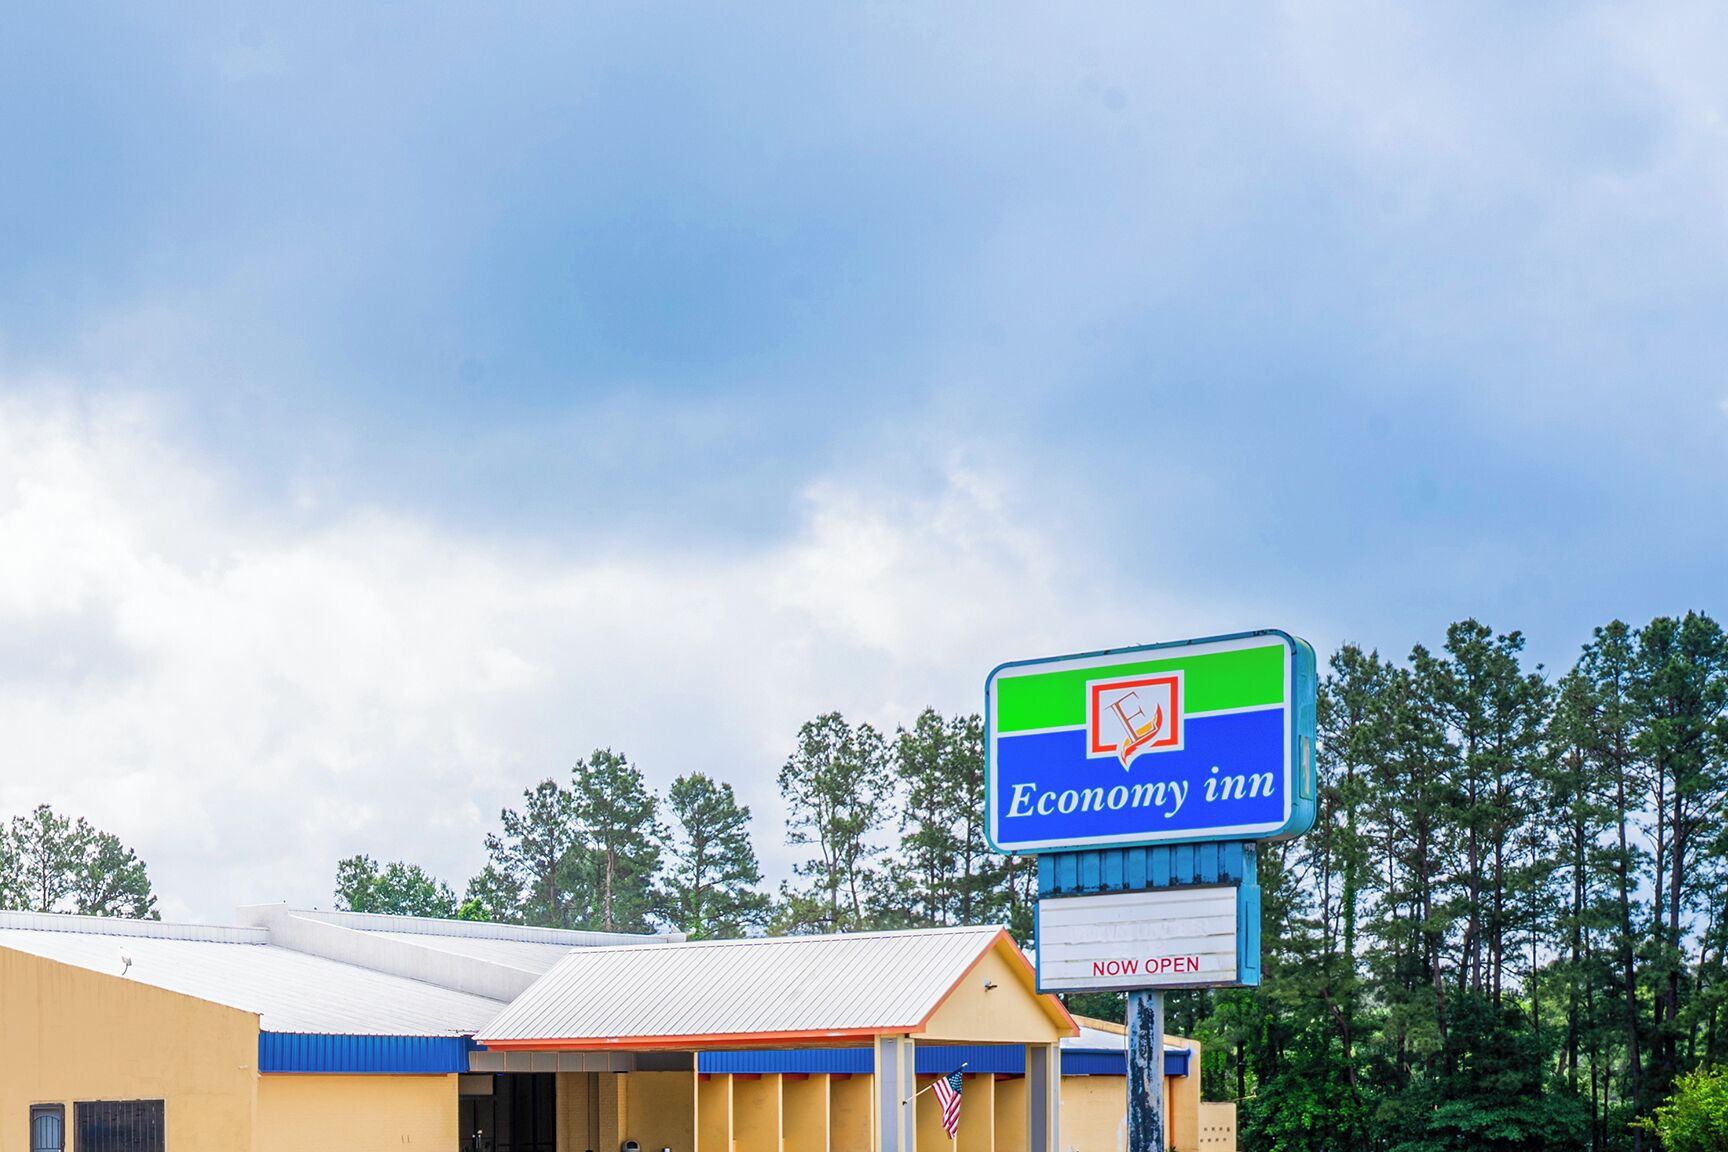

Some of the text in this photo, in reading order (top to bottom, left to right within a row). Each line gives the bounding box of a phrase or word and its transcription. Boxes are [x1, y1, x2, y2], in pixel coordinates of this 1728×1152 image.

[1006, 766, 1275, 819] Economy inn
[1092, 956, 1199, 976] NOW OPEN
